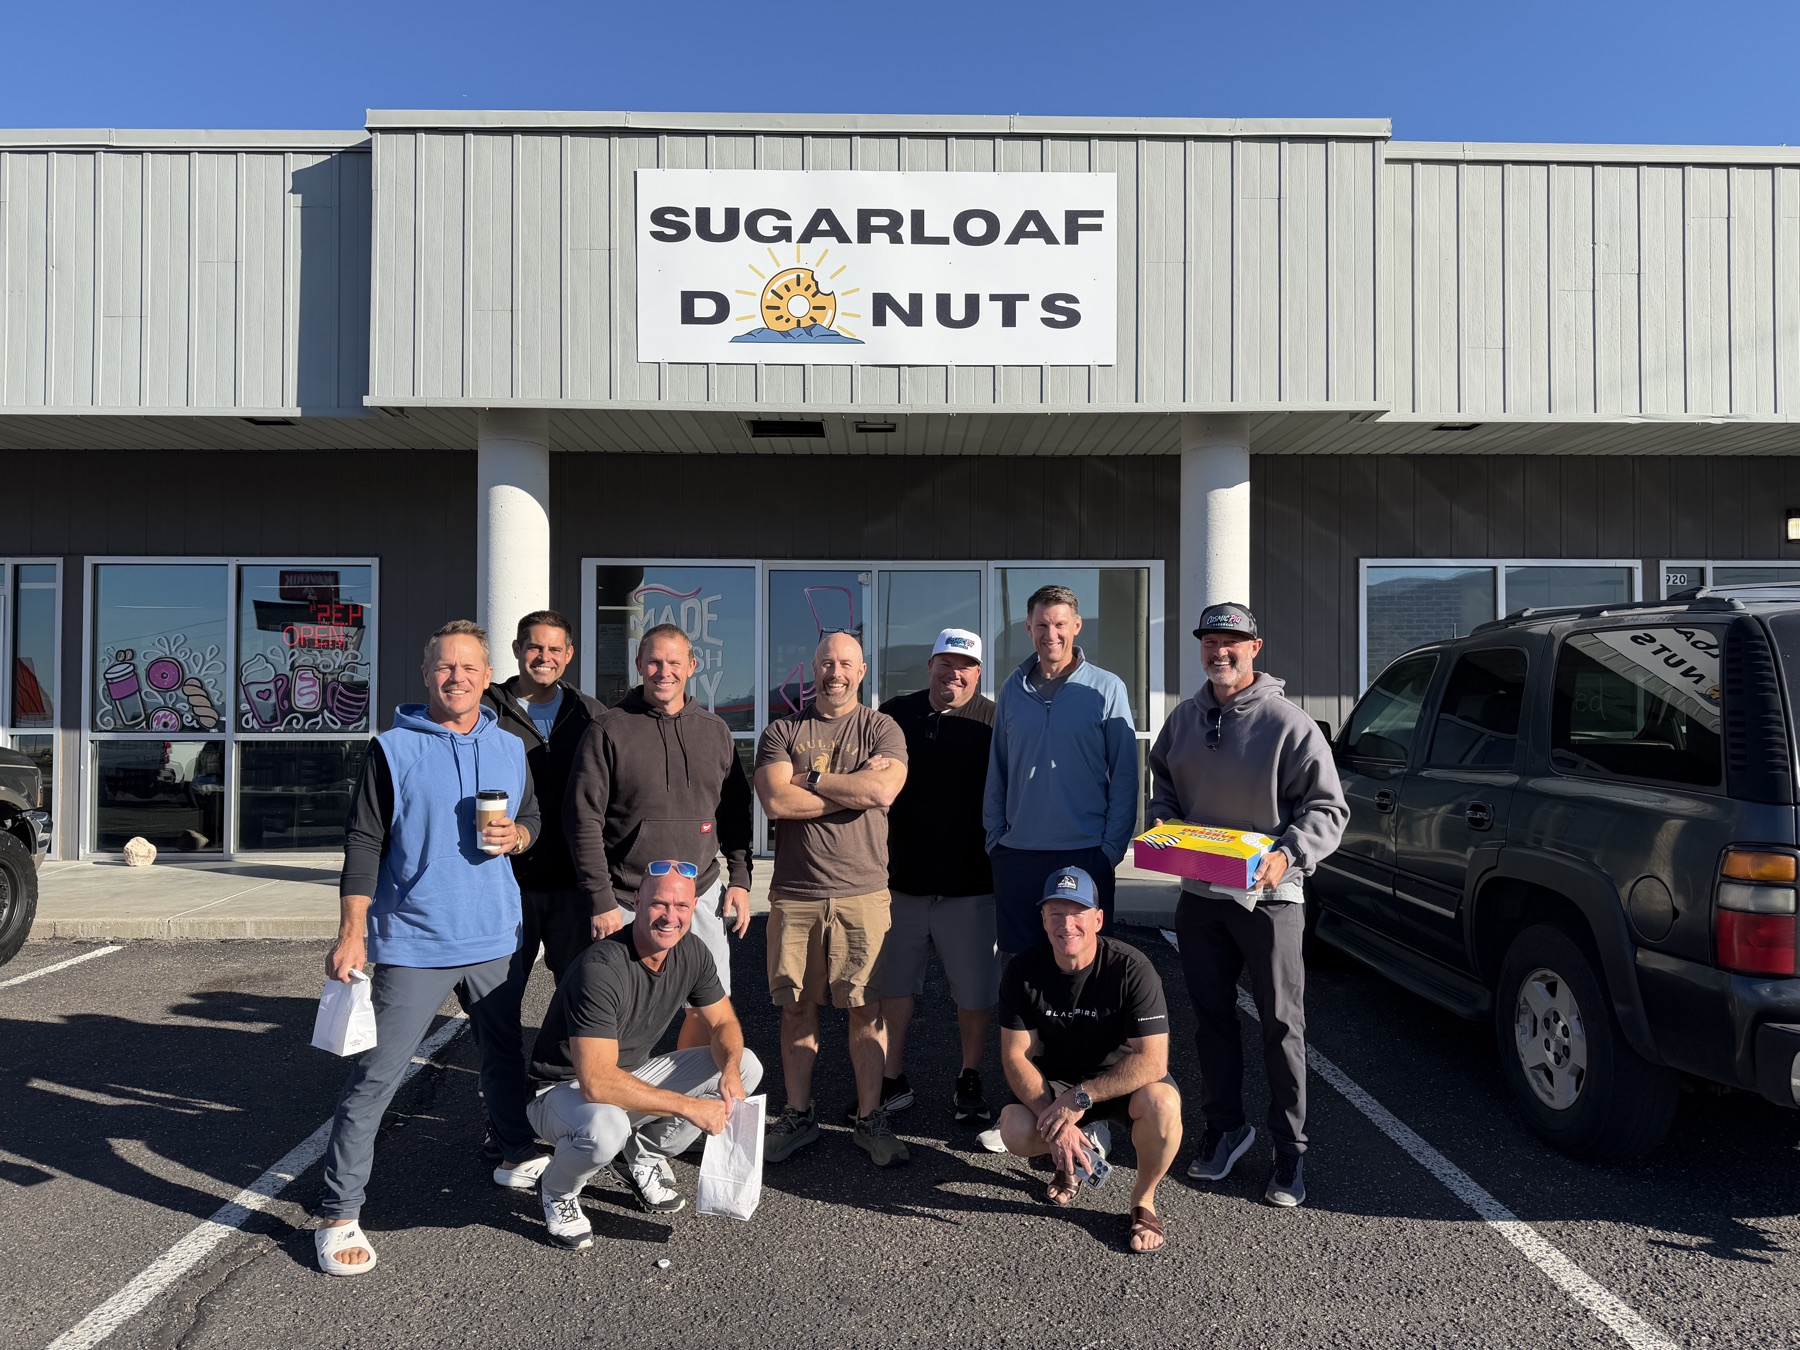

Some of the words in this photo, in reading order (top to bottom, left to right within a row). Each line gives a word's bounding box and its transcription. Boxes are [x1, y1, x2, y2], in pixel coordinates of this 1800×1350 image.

[649, 206, 1104, 246] SUGARLOAF
[629, 594, 723, 646] MADE
[283, 625, 344, 647] OPEN
[1182, 828, 1238, 841] DESERVE
[1189, 832, 1233, 843] DONUT
